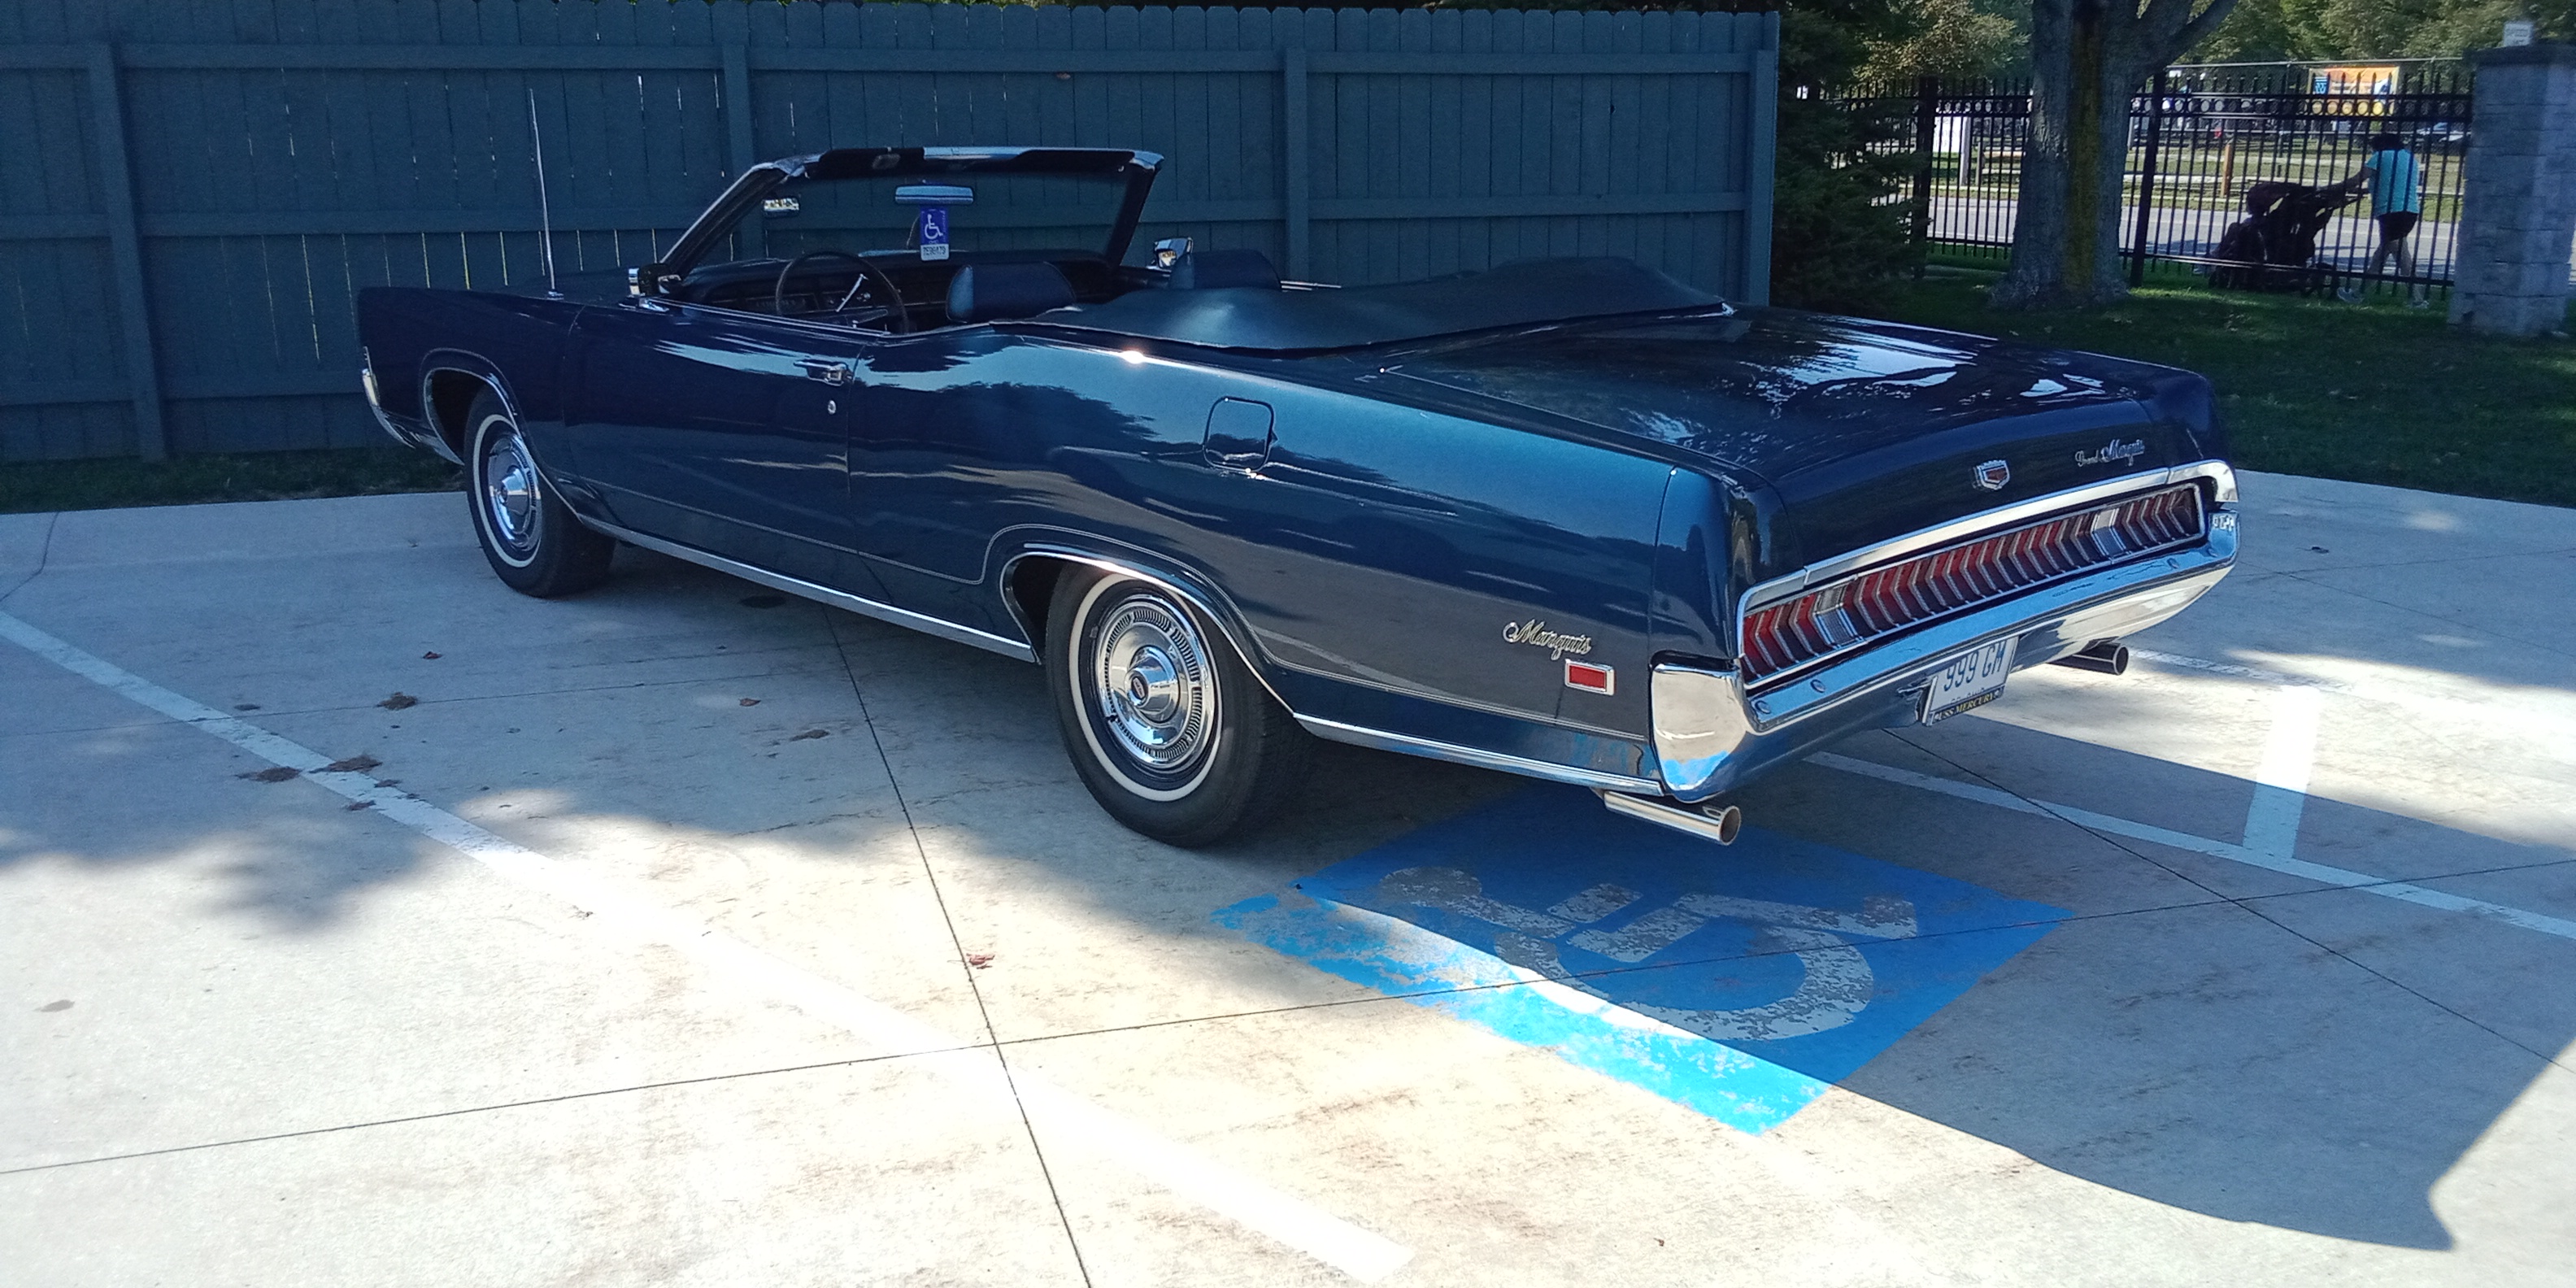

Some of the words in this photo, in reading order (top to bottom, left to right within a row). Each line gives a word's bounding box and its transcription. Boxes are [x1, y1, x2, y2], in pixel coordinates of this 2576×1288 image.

[2074, 450, 2099, 467] Grand
[2100, 438, 2145, 467] Marquis
[1503, 619, 1592, 660] Marquis
[1943, 651, 1980, 691] 999
[1955, 692, 1994, 714] MERCURY
